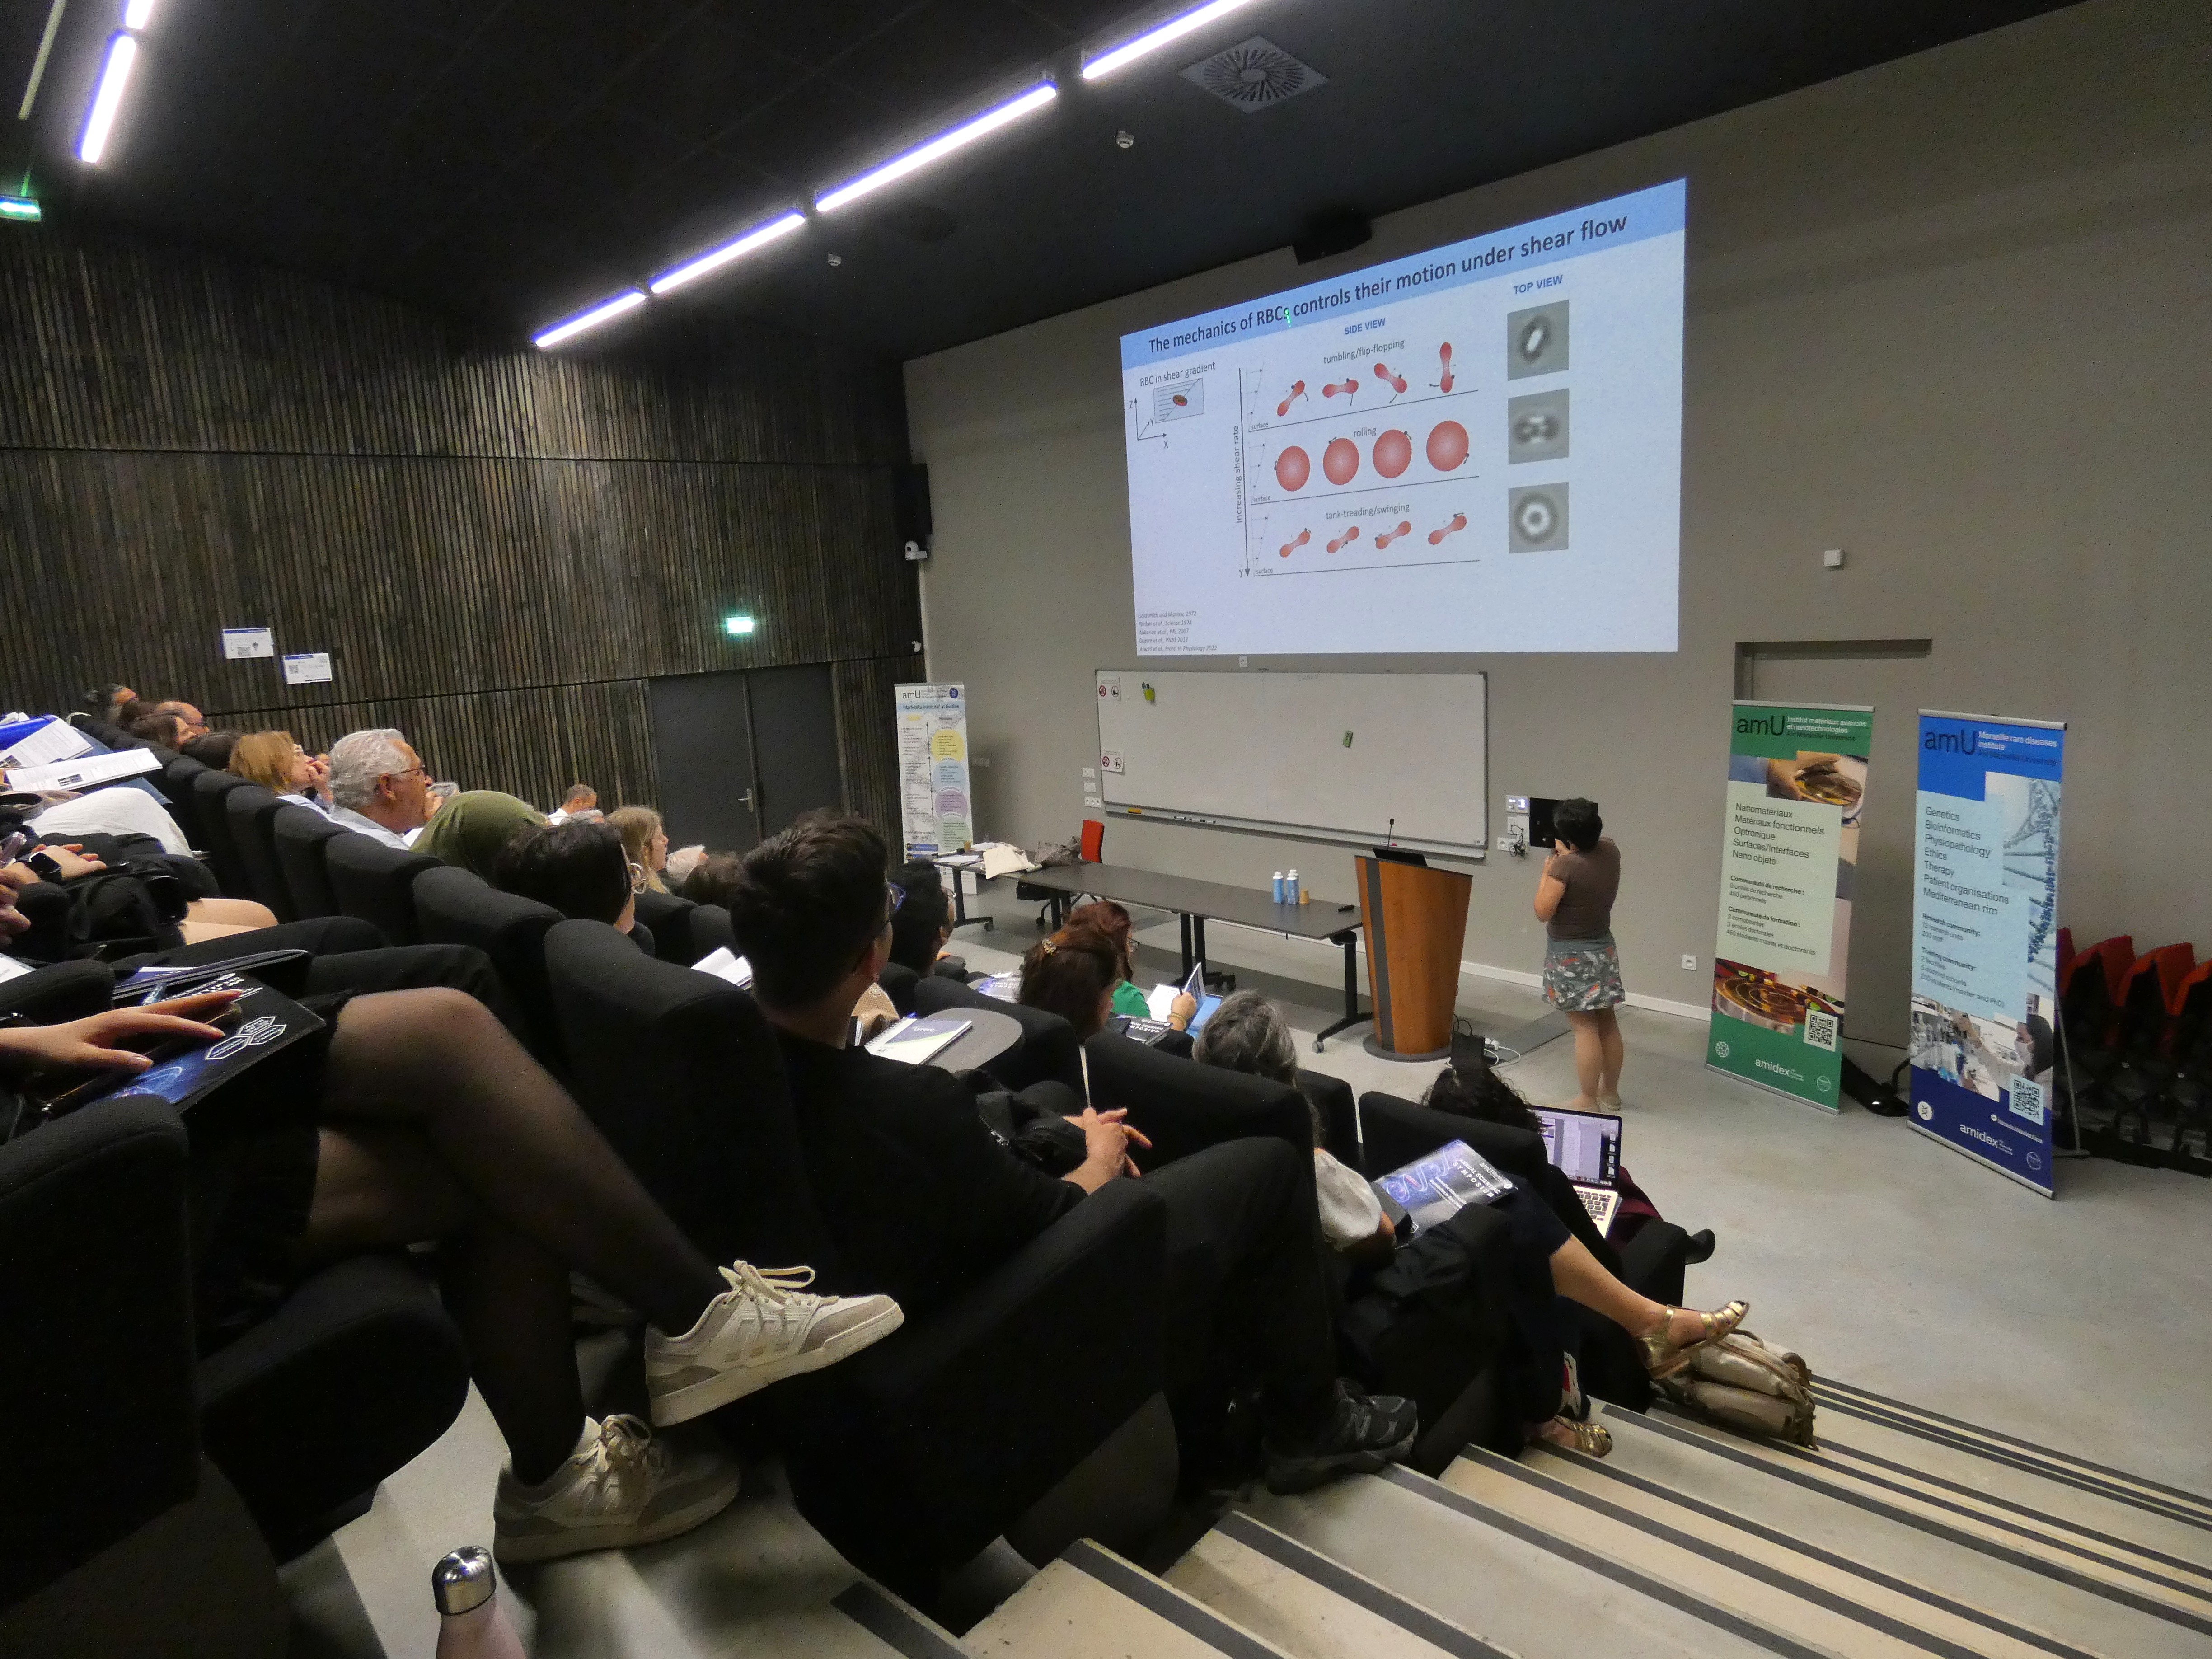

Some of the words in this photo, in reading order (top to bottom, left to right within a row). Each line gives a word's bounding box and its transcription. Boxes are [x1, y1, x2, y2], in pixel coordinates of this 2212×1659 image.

[1149, 337, 1169, 353] The
[1173, 320, 1236, 348] mechanics
[1240, 313, 1253, 330] of
[1257, 308, 1289, 326] RBCs
[1293, 290, 1351, 317] controls
[1354, 276, 1390, 300] their
[1397, 261, 1455, 289] motion
[1462, 244, 1514, 271] under
[1521, 229, 1575, 257] shear
[1580, 216, 1627, 241] flow
[1514, 281, 1533, 294] TOP
[1536, 275, 1563, 289] VIEW
[1345, 323, 1362, 335] SIDE
[1364, 318, 1386, 331] VIEW
[1323, 339, 1405, 364] tumbling/flip-flopping
[1140, 376, 1153, 386] RBC
[1155, 375, 1162, 384] in
[1163, 370, 1183, 382] shear
[1185, 362, 1216, 378] gradient
[1353, 426, 1376, 438] rolling
[1163, 441, 1168, 449] X
[1326, 503, 1410, 520] tank-treading/swinging
[902, 690, 921, 699] amU
[1736, 715, 1786, 736] amU
[1924, 729, 1978, 755] amU
[1925, 806, 1960, 822] Genetics
[1734, 826, 1775, 840] Optronique
[1773, 820, 1824, 835] fonctionnels
[1925, 820, 1981, 841] Bioinformatics
[1733, 838, 1809, 858] Surfaces/Interfaces
[1924, 847, 1948, 860] Ethics
[1925, 833, 1992, 858] Physiopathology
[1732, 849, 1752, 861] Nano
[1753, 854, 1776, 865] objets
[1924, 860, 1955, 877] Therapy
[1773, 885, 1801, 895] recherche
[1923, 874, 1950, 890] Patient
[1950, 882, 2009, 904] organisations
[1923, 887, 1980, 912] Mediterranean
[1982, 904, 1998, 915] rim
[1770, 916, 1797, 927] formation
[1755, 1059, 1791, 1077] amidex
[1959, 1124, 1999, 1148] amidex
[1453, 1162, 1495, 1198] SYMPOSIUM
